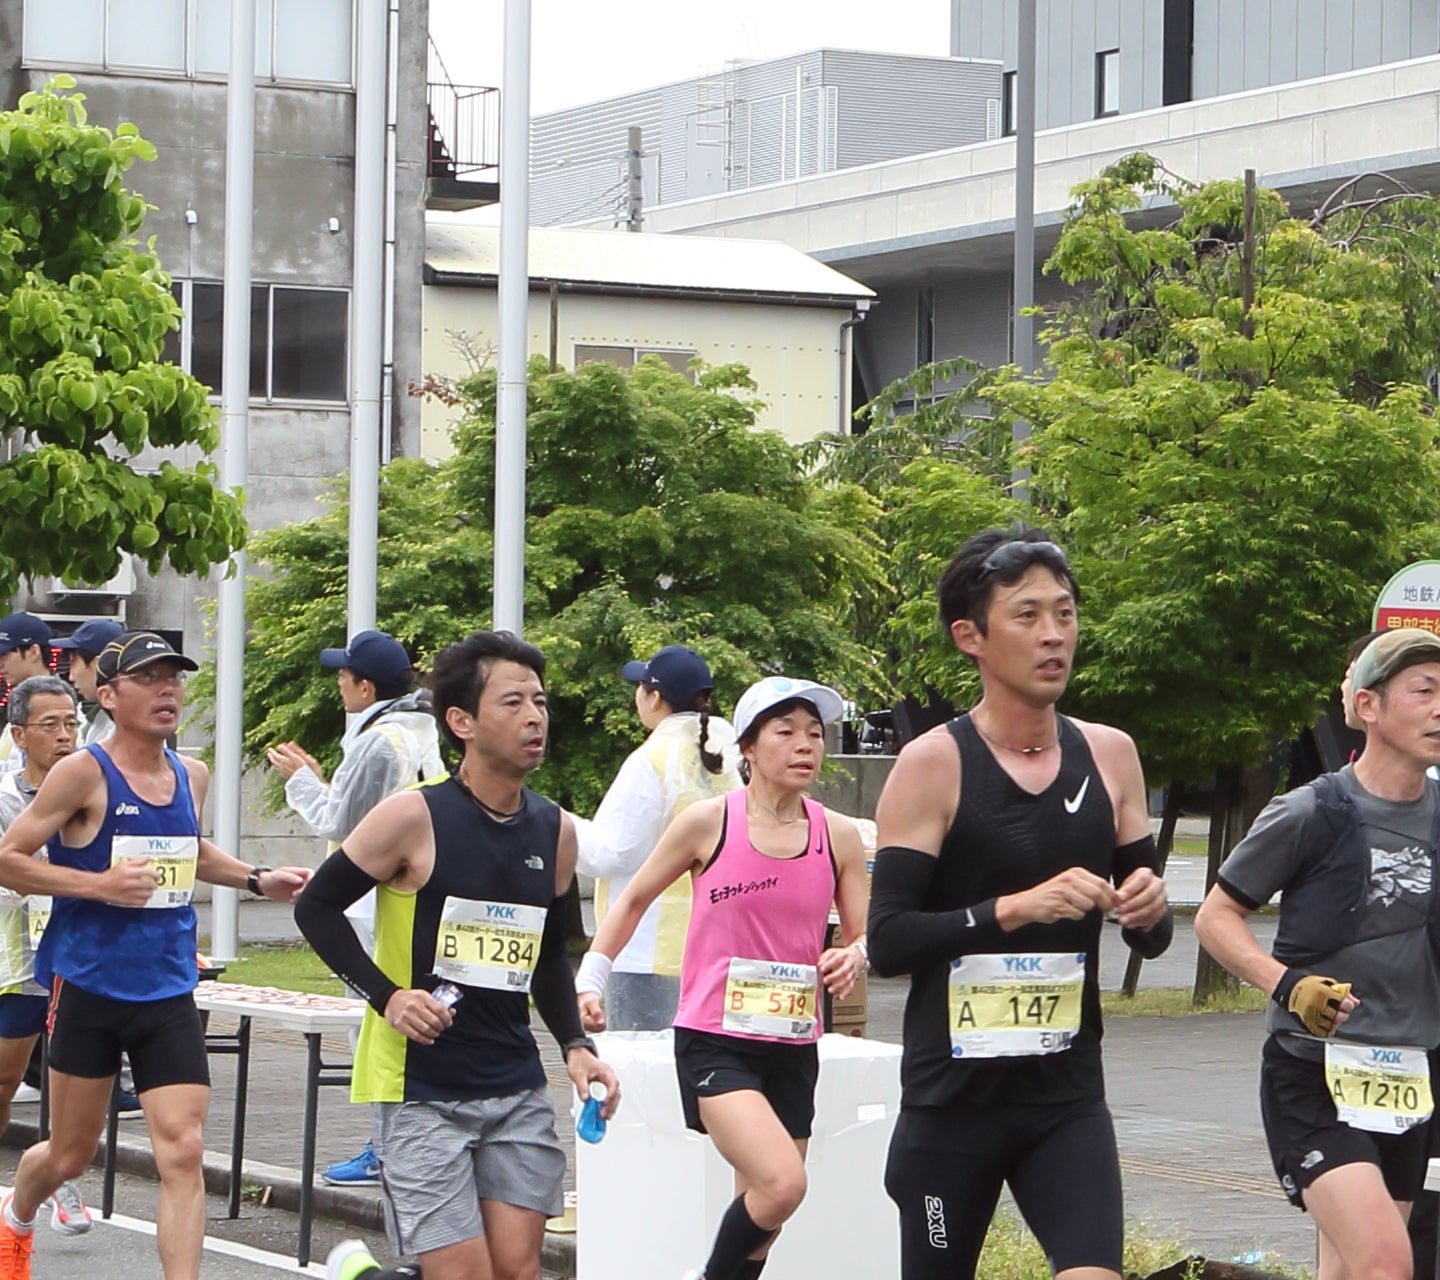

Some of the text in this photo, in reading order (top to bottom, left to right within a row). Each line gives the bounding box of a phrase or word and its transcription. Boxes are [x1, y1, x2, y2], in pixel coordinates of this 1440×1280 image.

[147, 839, 173, 850] YKK
[486, 904, 517, 920] YKK
[443, 934, 535, 968] B 1284
[769, 964, 802, 979] YKK
[1002, 957, 1042, 972] YKK
[730, 990, 808, 1017] B 519
[956, 994, 1061, 1029] A 147
[1371, 1048, 1403, 1064] YKK
[1333, 1078, 1419, 1111] A 1210
[925, 1195, 948, 1248] 2XU
